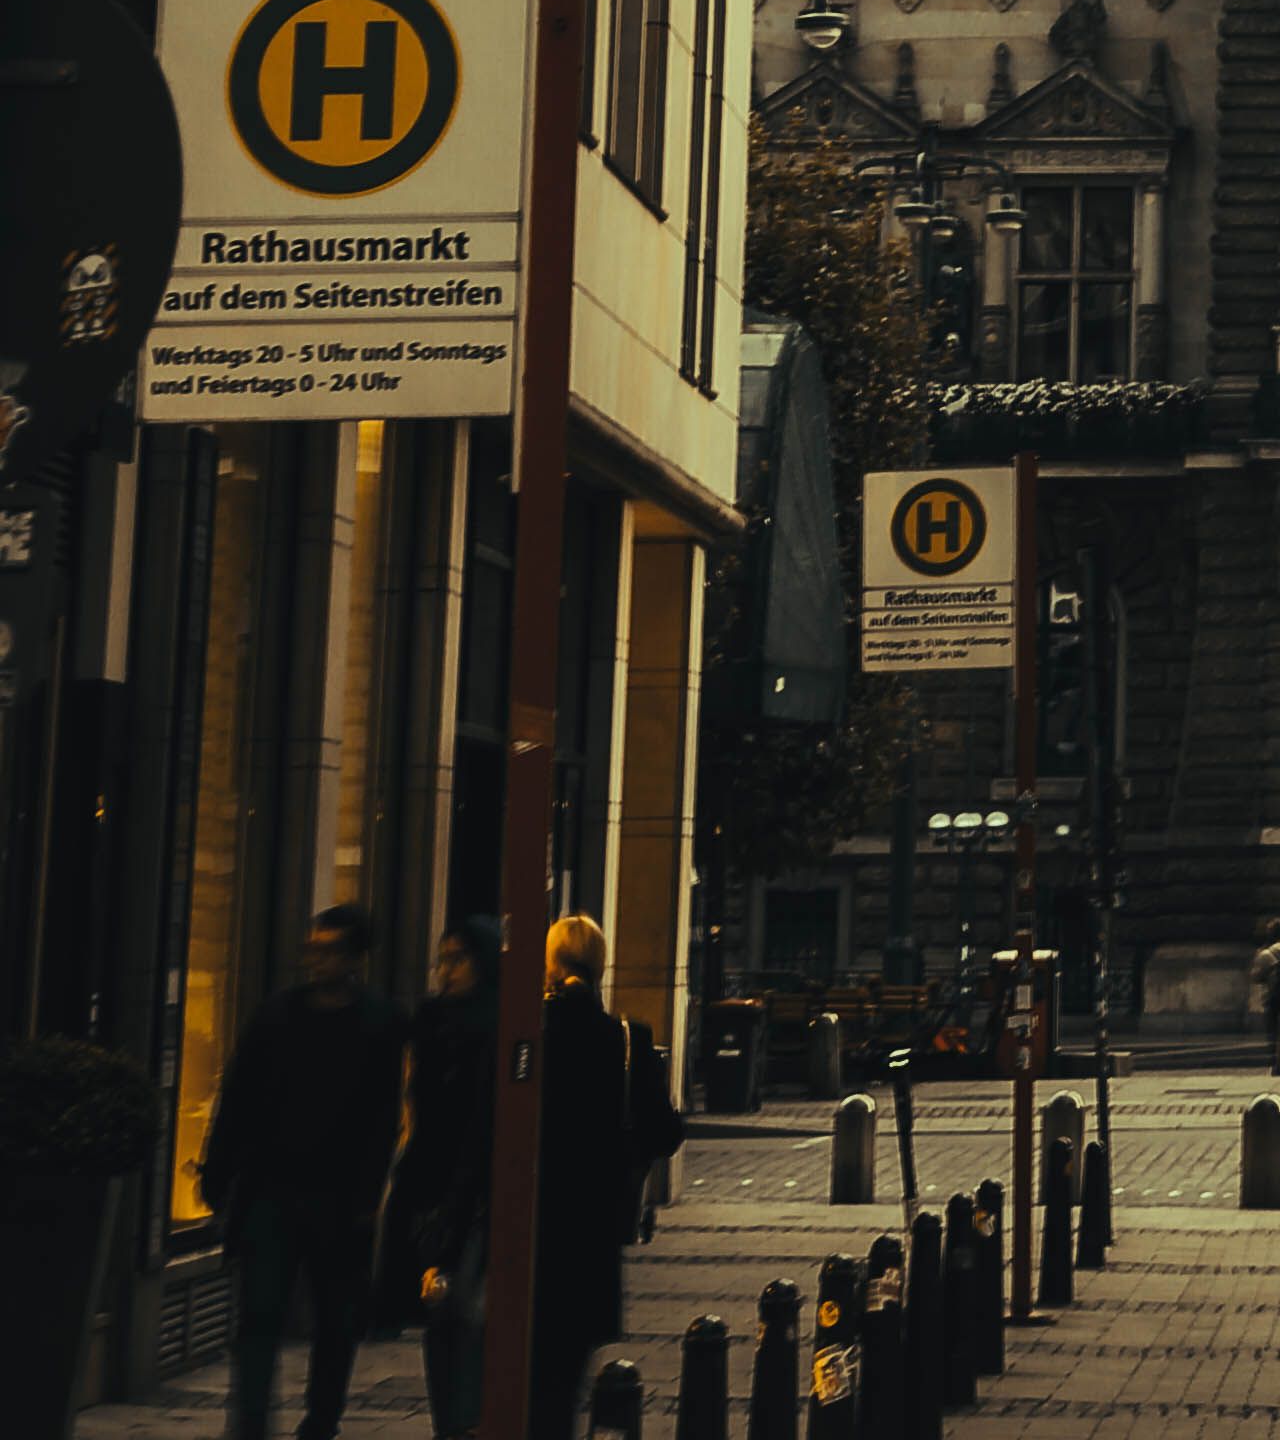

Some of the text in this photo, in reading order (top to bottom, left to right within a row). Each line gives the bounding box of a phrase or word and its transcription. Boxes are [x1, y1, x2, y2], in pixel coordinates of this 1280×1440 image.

[289, 20, 398, 142] H
[201, 227, 470, 264] Rathausmarkt
[163, 279, 503, 311] auf dem Seitenstreifen
[152, 344, 253, 370] Werktags
[256, 344, 284, 364] 20
[299, 343, 314, 364] 5
[318, 342, 357, 363] Uhr
[361, 342, 404, 362] und
[406, 341, 508, 365] Sonntags
[150, 374, 194, 395] und
[197, 374, 297, 398] Feiertags
[300, 373, 315, 392] 0
[330, 373, 358, 392] 24
[361, 371, 402, 392] Uhr
[916, 500, 961, 554] H
[884, 587, 997, 607] Rathausmarkt
